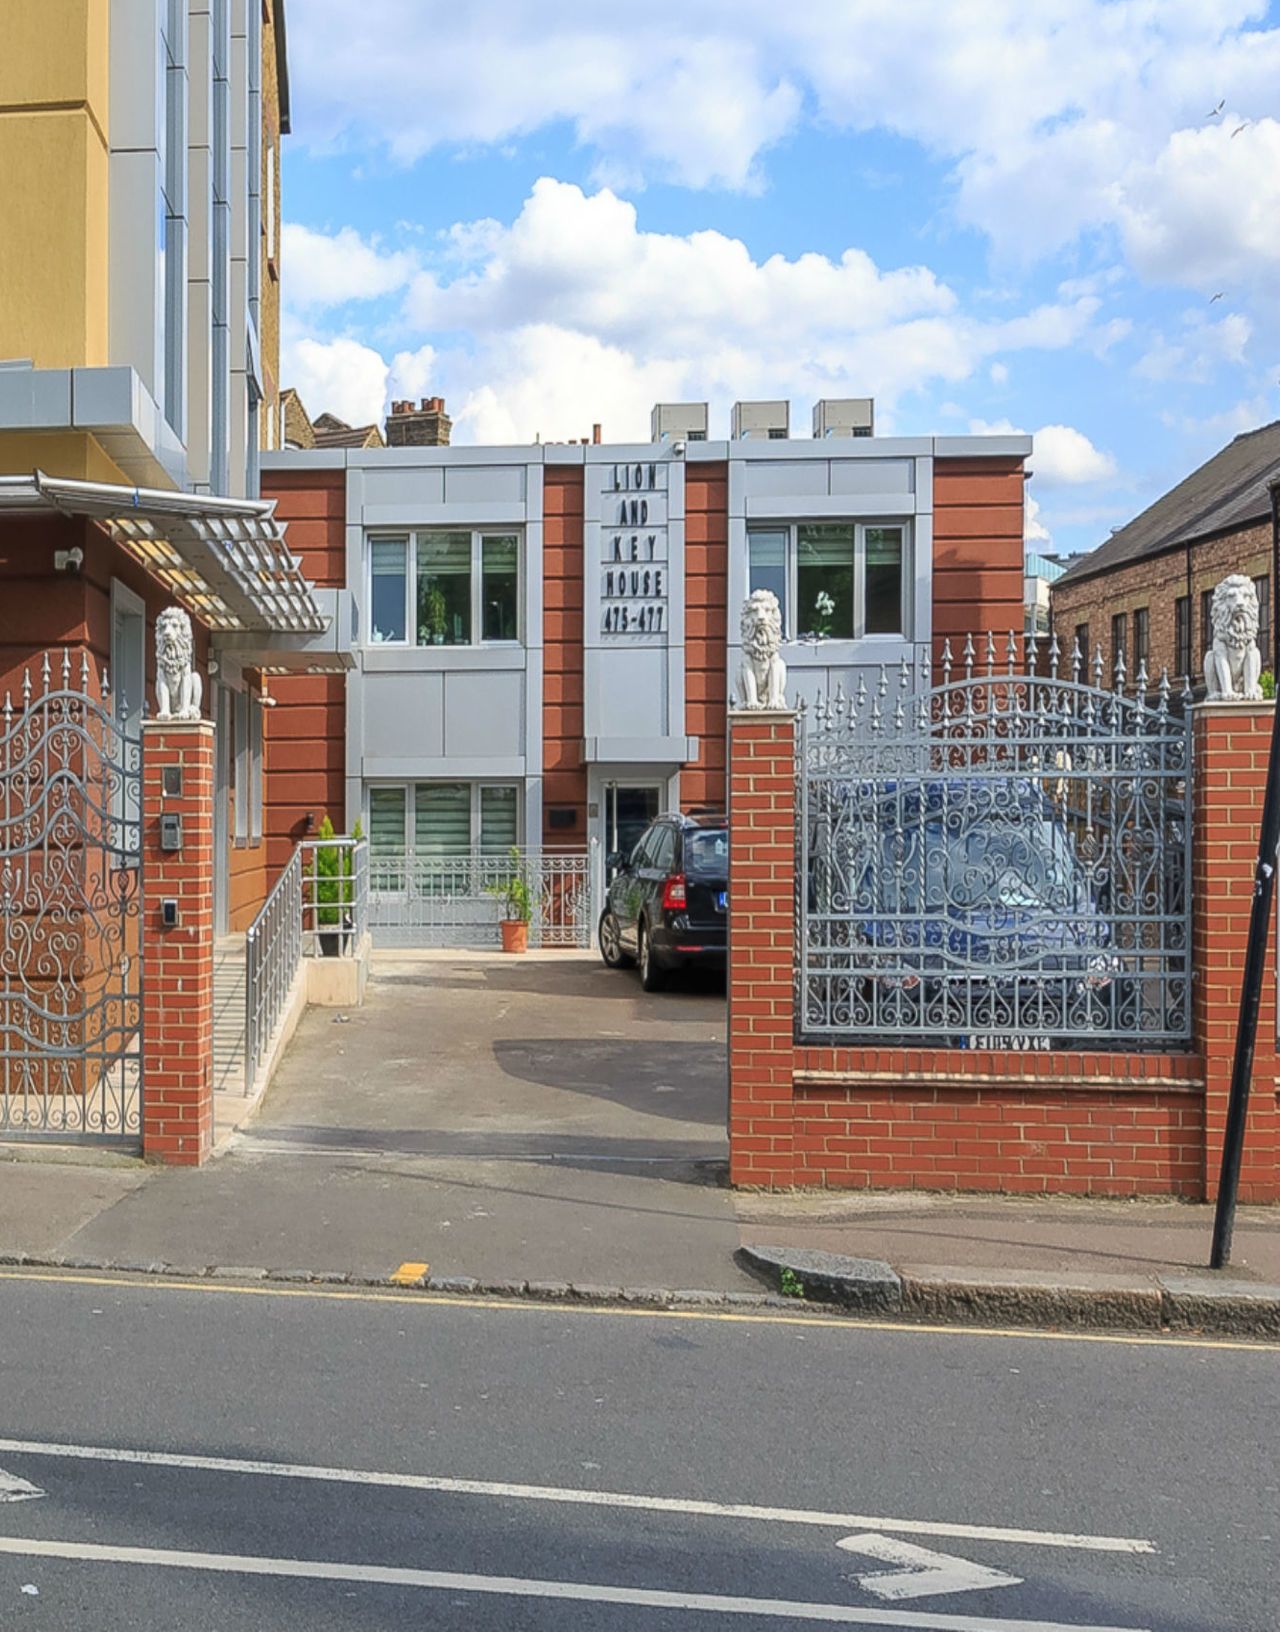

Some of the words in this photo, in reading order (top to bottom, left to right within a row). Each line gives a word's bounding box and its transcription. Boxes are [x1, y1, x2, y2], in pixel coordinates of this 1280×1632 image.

[613, 464, 657, 492] LION
[619, 499, 649, 526] AND
[613, 535, 657, 562] KEY
[606, 570, 662, 598] HOUSE
[604, 606, 664, 633] 475-477
